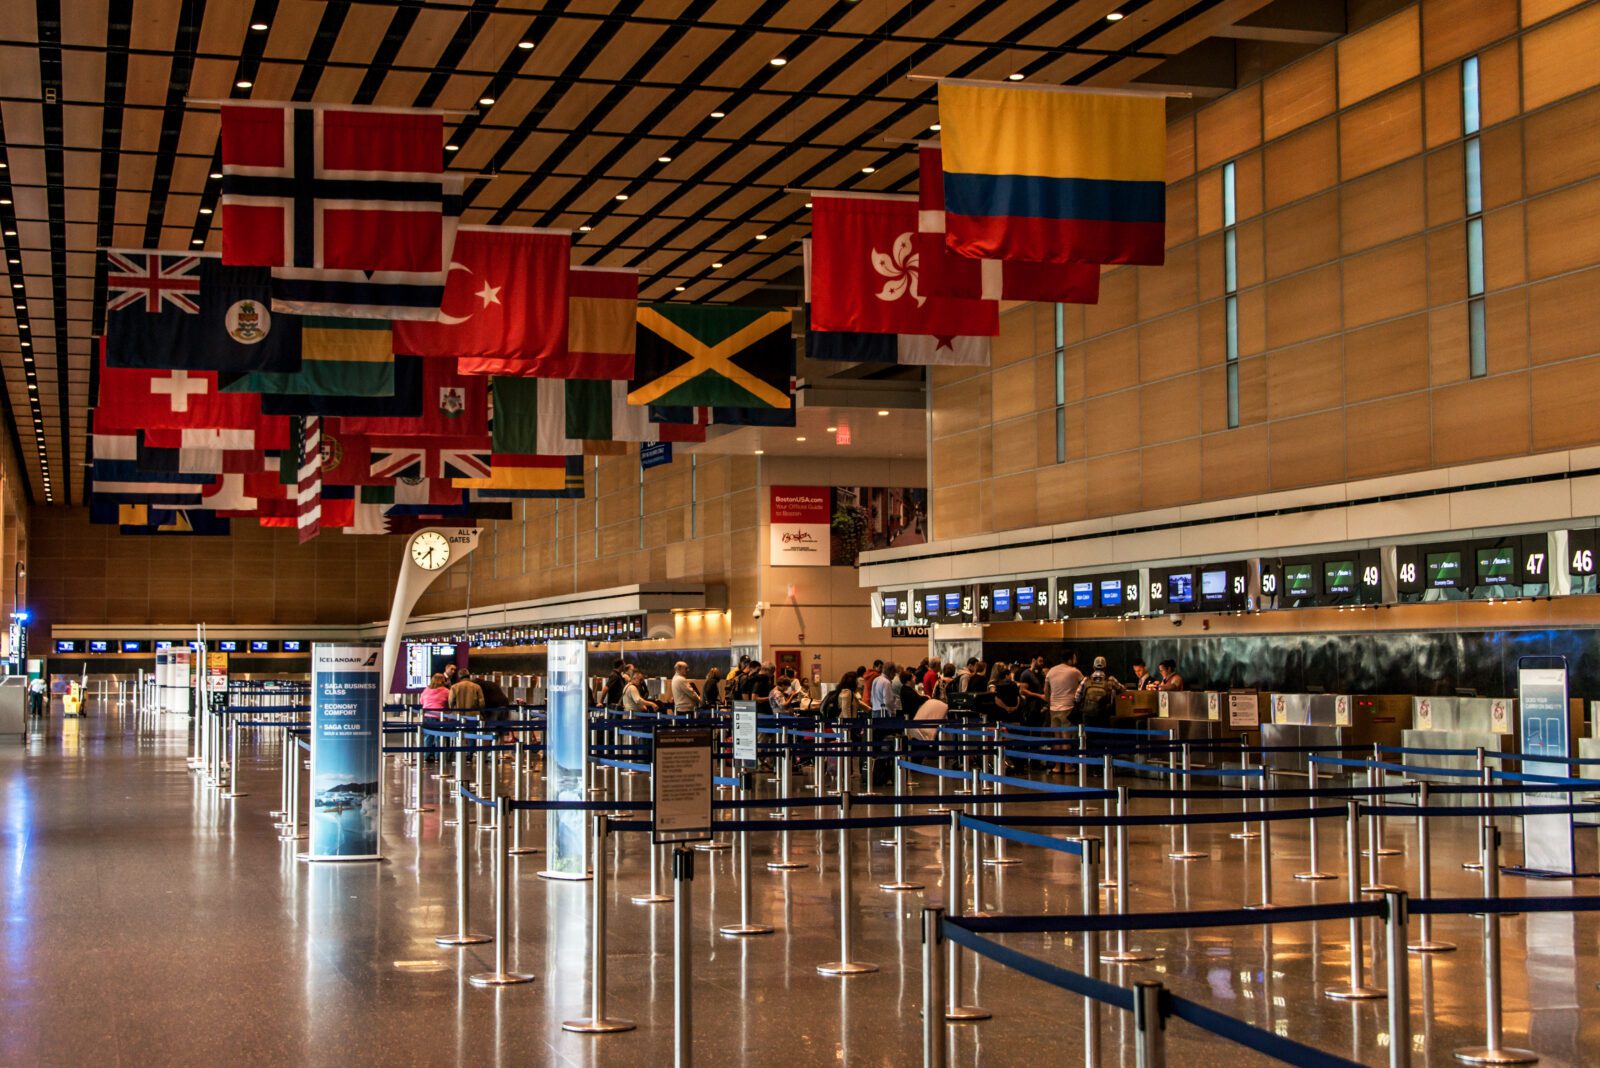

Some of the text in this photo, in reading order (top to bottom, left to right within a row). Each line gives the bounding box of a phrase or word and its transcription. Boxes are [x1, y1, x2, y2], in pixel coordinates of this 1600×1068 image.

[1526, 553, 1544, 574] 47
[1572, 550, 1592, 572] 46
[1363, 566, 1378, 586] 49
[1400, 563, 1416, 582] 48
[1151, 583, 1162, 599] 52
[1234, 576, 1244, 594] 51
[1262, 574, 1276, 592] 50
[1038, 591, 1047, 606] 55
[1058, 590, 1068, 605] 54
[1127, 585, 1137, 601] 53
[914, 600, 922, 613] 58
[963, 597, 971, 610] 57
[980, 596, 988, 610] 56
